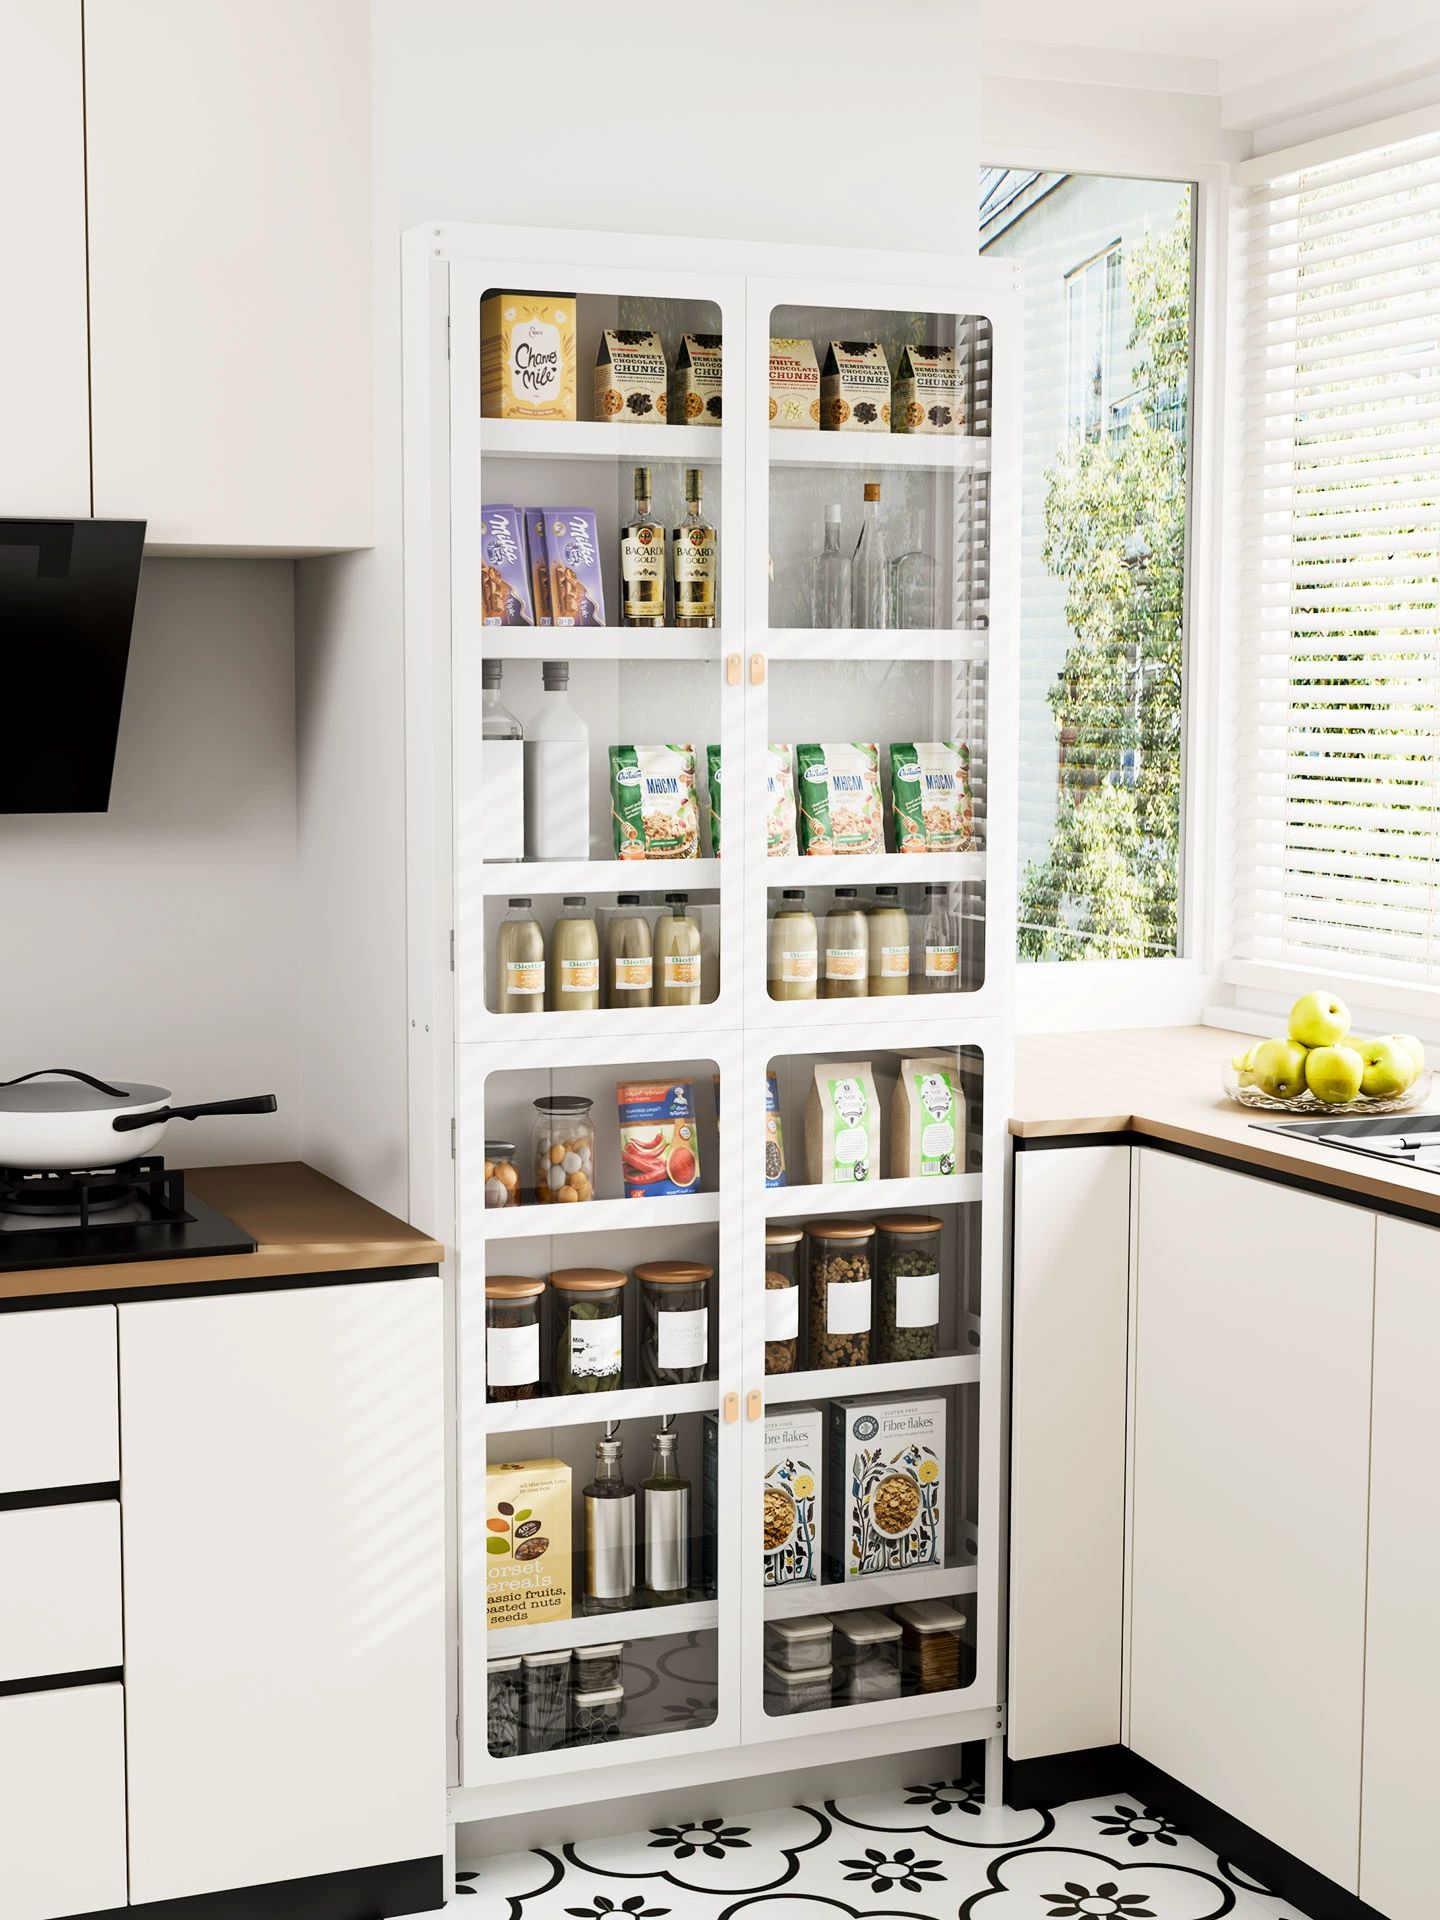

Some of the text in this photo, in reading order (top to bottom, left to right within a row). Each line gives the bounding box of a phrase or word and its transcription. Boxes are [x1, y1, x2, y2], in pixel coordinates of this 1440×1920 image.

[612, 352, 663, 360] SEMISWEET
[613, 358, 665, 366] CHOCOLATE
[839, 363, 887, 371] SEMISWEET
[614, 364, 665, 374] CHUNKS
[694, 368, 722, 376] CHU
[769, 365, 818, 373] CHOCOLATE
[769, 371, 818, 381] CHUNKS
[841, 375, 890, 384] CHUNKS
[489, 513, 518, 565] Milka
[569, 516, 595, 568] Milka
[634, 556, 656, 564] GOLD
[685, 557, 708, 565] GOLD
[646, 777, 679, 794] МЮСЛИ
[832, 775, 864, 791] МЮСЛИ
[925, 774, 956, 790] МЮСЛИ
[883, 1416, 934, 1431] Fibre flakes
[764, 1430, 809, 1446] bre flakes
[488, 1560, 544, 1579] orset
[487, 1574, 553, 1593] ereals
[487, 1592, 522, 1605] assic
[530, 1598, 562, 1609] nuts
[490, 1612, 528, 1624] seeds
